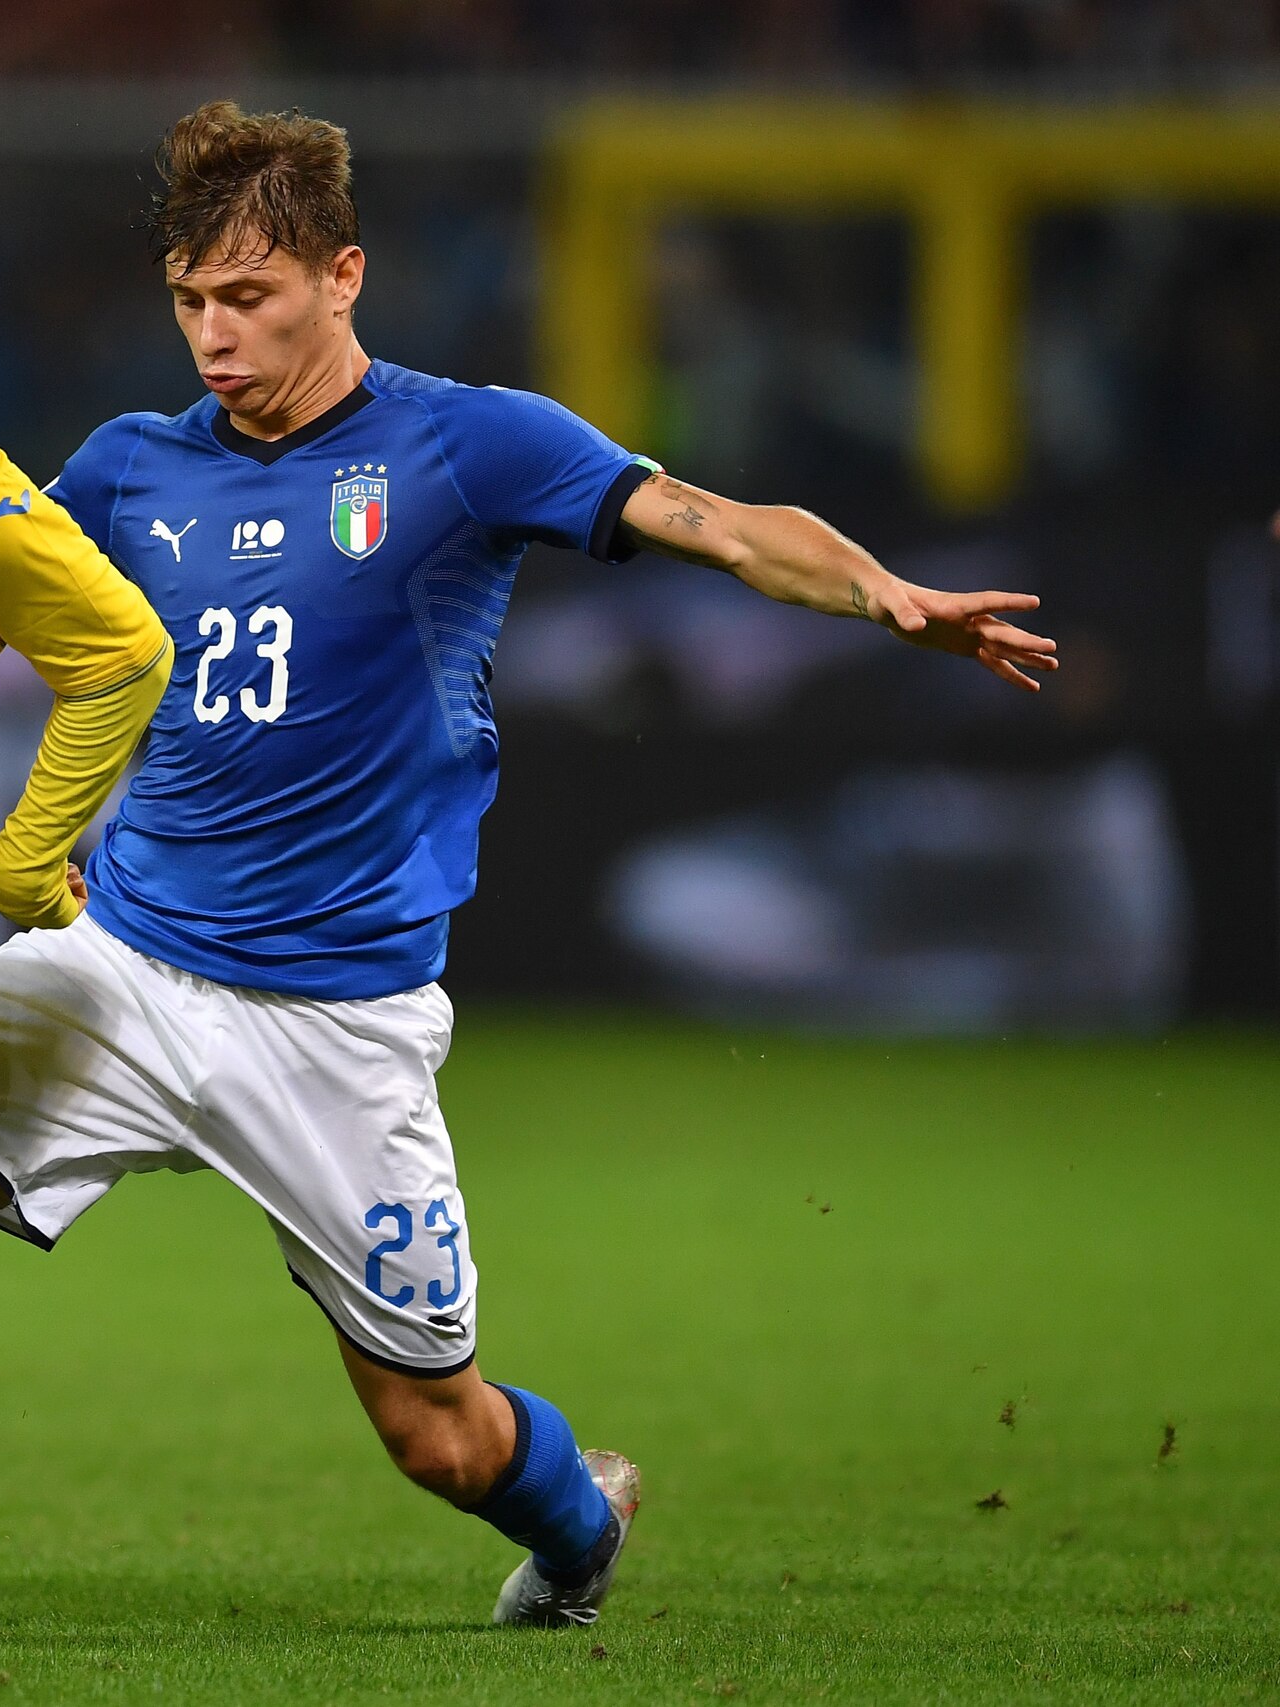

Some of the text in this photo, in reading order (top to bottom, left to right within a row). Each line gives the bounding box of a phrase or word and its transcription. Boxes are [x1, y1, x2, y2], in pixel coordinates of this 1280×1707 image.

[337, 483, 381, 499] ITALIA
[231, 518, 286, 551] 120
[193, 605, 294, 724] 23
[365, 1198, 461, 1310] 23
